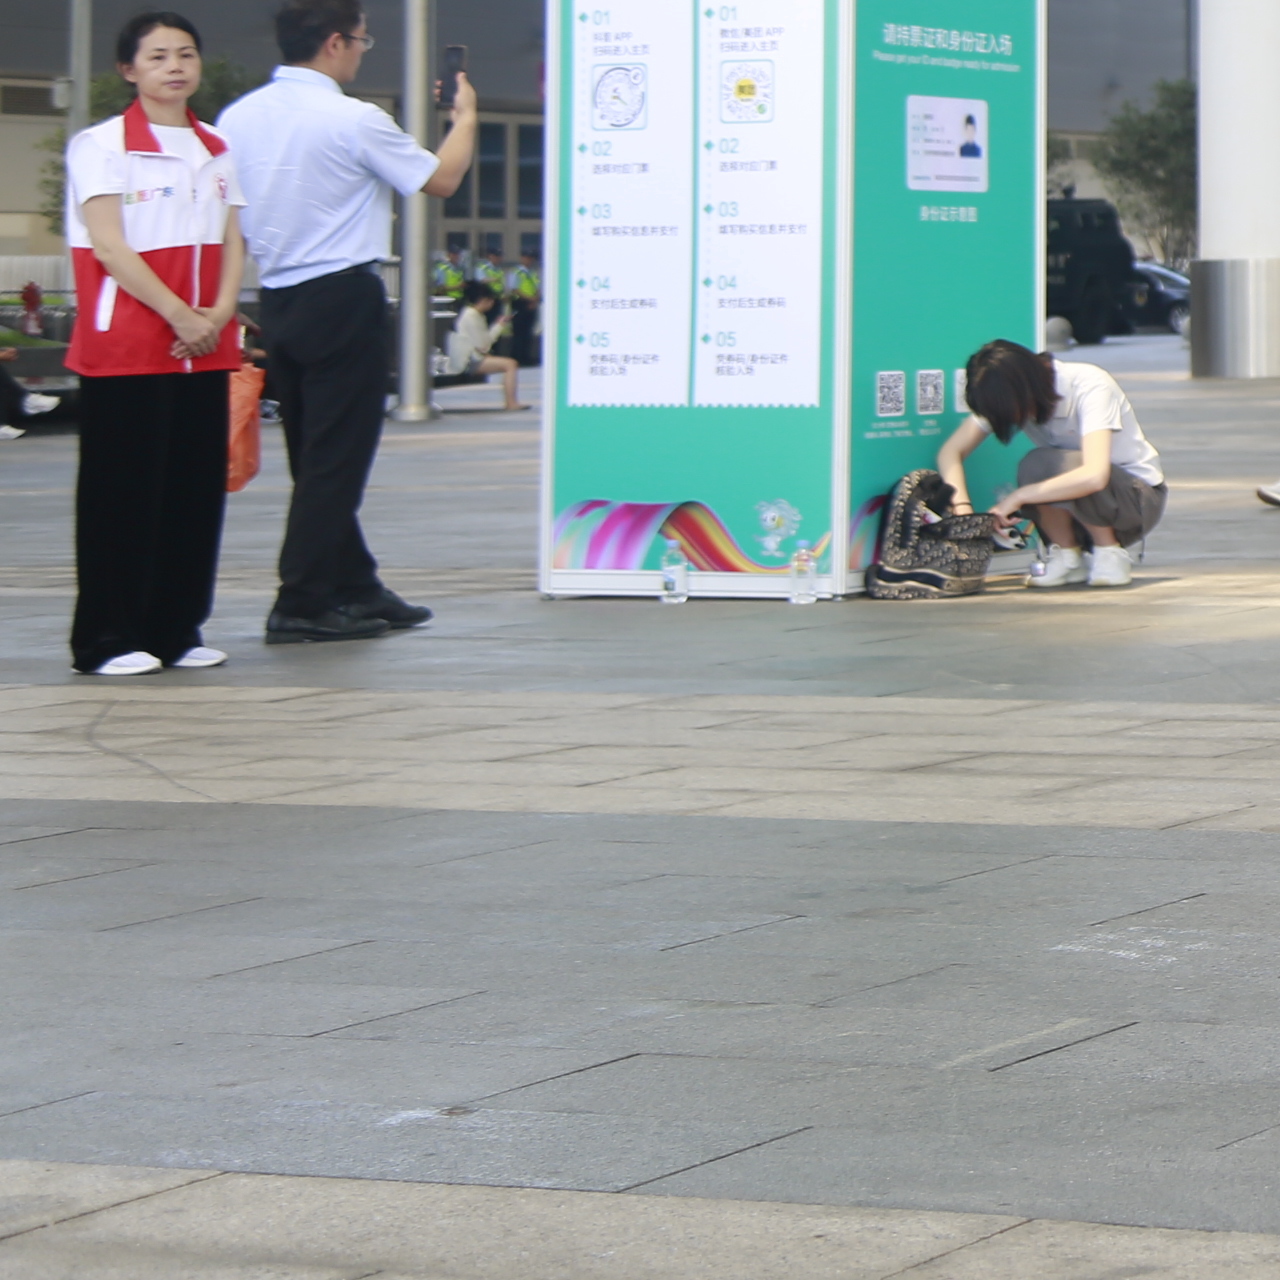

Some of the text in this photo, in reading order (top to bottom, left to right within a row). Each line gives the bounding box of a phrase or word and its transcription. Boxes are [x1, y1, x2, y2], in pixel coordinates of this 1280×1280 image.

[592, 11, 611, 25] 01
[719, 6, 739, 21] 01
[882, 22, 1013, 56] 请持票证和身份证入场
[592, 141, 612, 156] 02
[719, 138, 740, 153] 02
[592, 204, 612, 219] 03
[718, 202, 739, 217] 03
[591, 276, 611, 291] 04
[717, 275, 737, 290] 04
[590, 332, 610, 347] 05
[716, 331, 737, 347] 05
